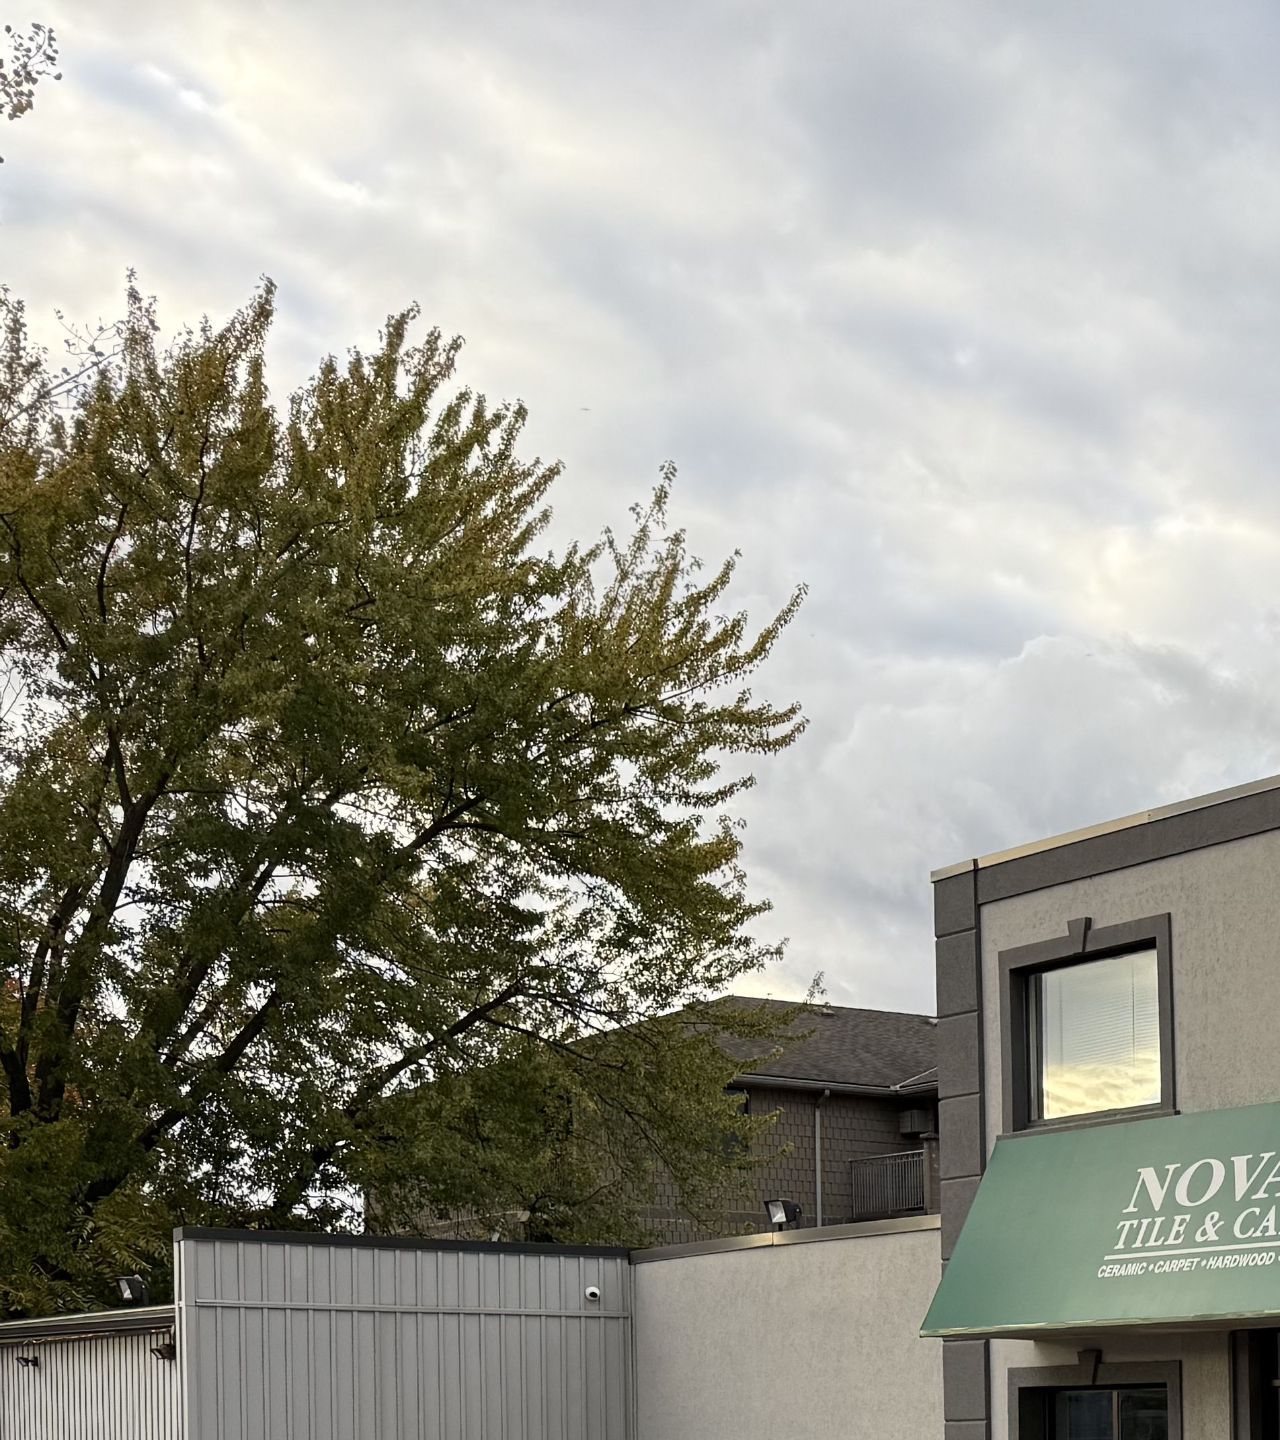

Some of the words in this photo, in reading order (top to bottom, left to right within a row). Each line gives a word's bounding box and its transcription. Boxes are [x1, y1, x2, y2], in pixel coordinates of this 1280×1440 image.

[1114, 1214, 1191, 1250] TILE
[1195, 1211, 1224, 1242] &
[1098, 1262, 1147, 1278] CERAMIC
[1154, 1257, 1200, 1274] CARPET
[1206, 1252, 1276, 1270] HARDWOOD
